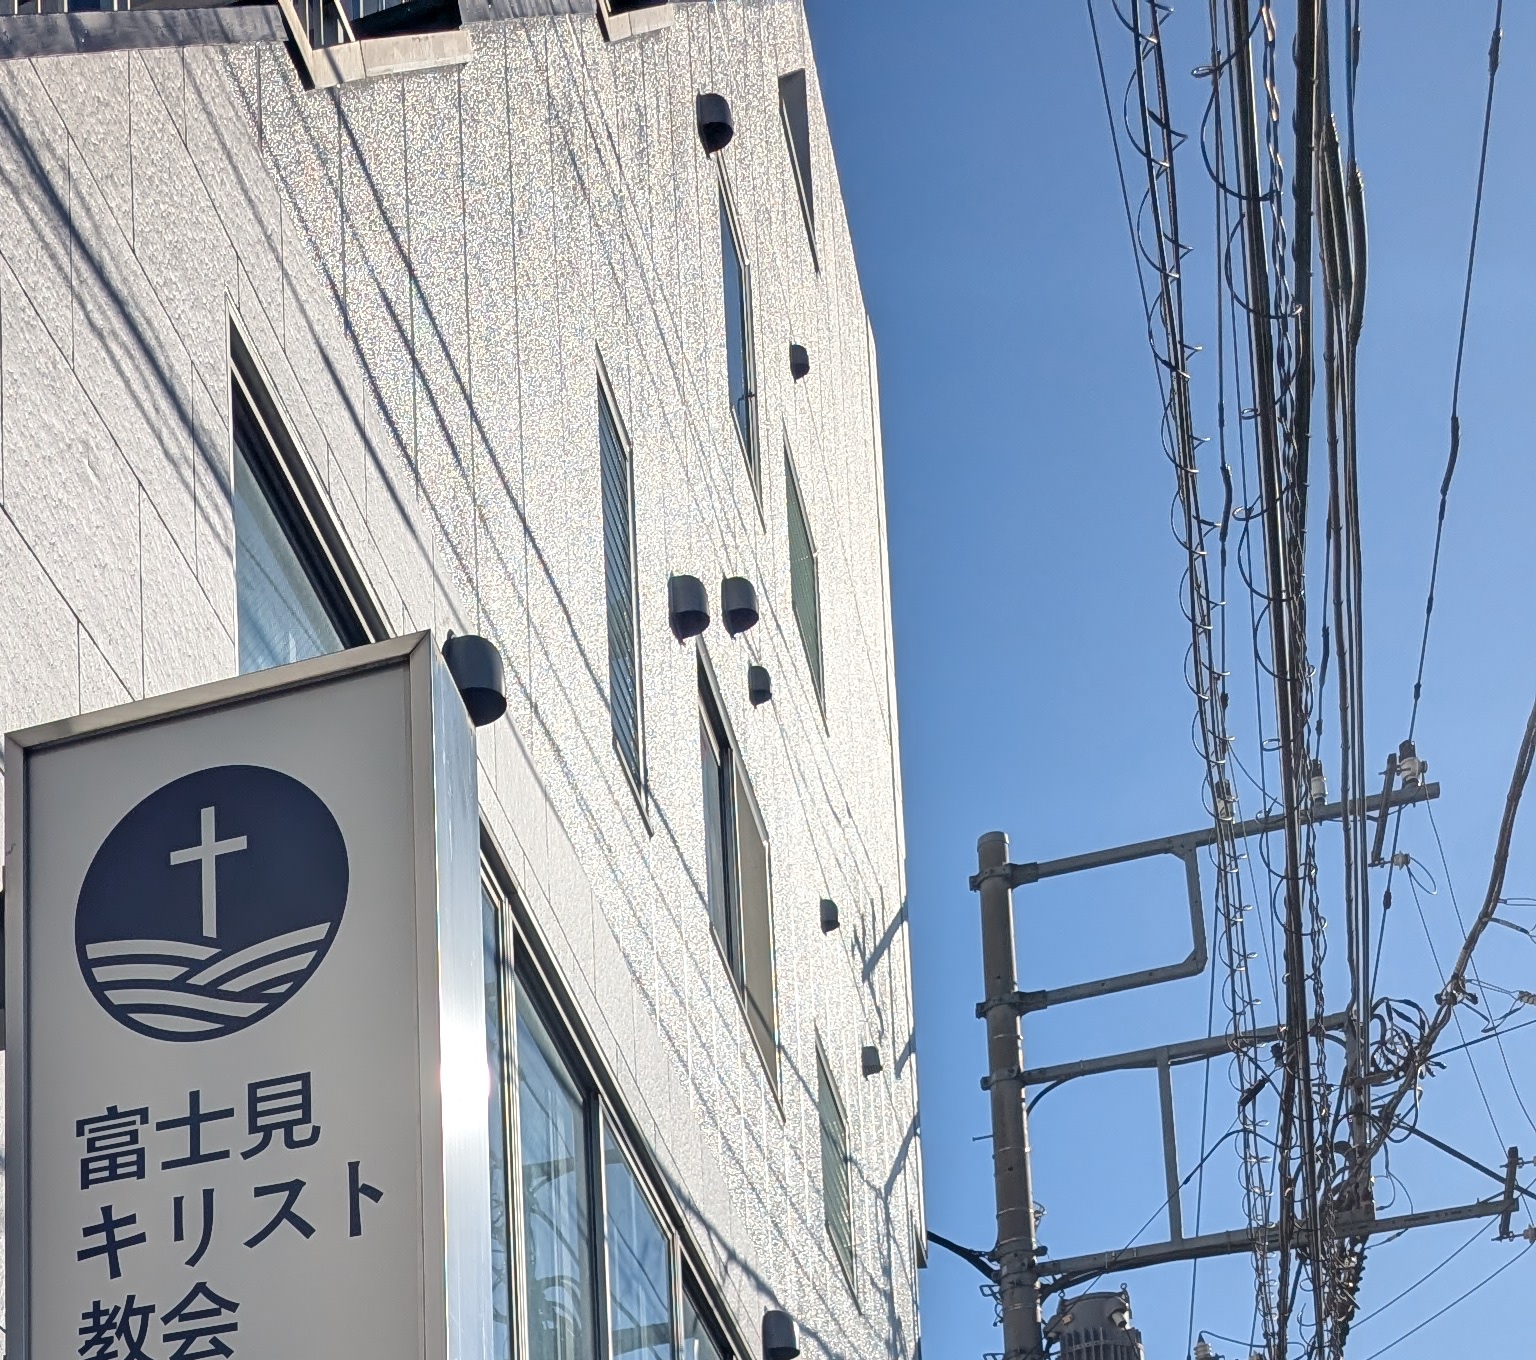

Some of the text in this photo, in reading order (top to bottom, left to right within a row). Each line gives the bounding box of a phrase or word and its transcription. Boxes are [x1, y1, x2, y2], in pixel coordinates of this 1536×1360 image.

[76, 1071, 321, 1190] 富士見
[77, 1160, 383, 1280] キリスト
